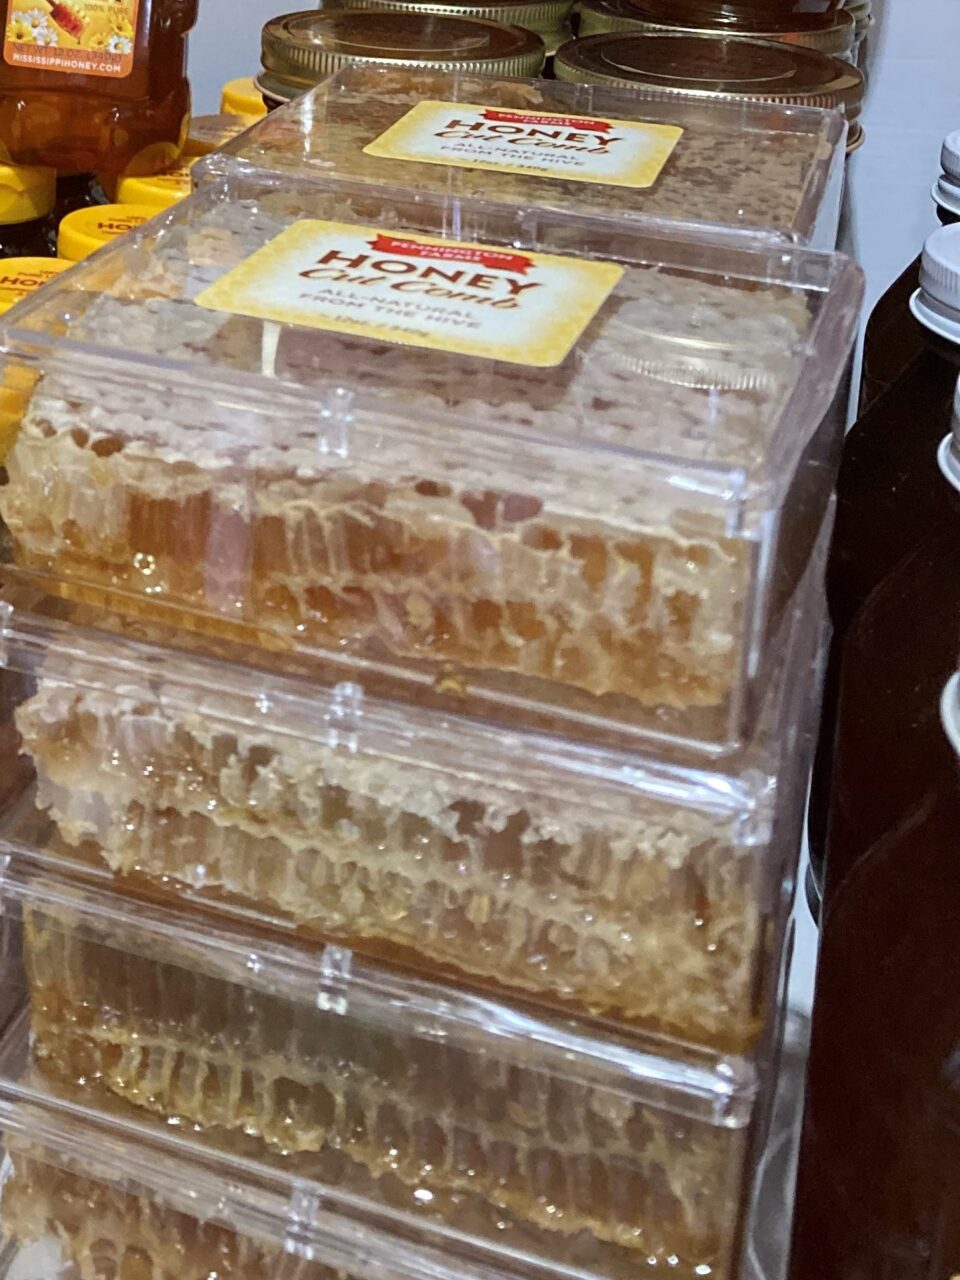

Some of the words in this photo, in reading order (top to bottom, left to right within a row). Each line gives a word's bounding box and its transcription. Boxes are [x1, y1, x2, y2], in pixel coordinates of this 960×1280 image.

[84, 3, 104, 13] 100%
[108, 6, 130, 15] PURE
[13, 53, 121, 72] MISSISSIPPIHONEY.COM
[498, 113, 596, 125] PENNINGTON
[434, 130, 503, 142] Cut
[507, 137, 610, 155] Comb
[445, 119, 624, 146] HONEY
[440, 145, 492, 156] FROM
[501, 153, 534, 161] THE
[542, 157, 586, 167] HIVE
[454, 142, 578, 161] ALL-NATURAL
[391, 240, 514, 261] PENNINGTON
[420, 250, 482, 262] FARMS
[317, 250, 543, 295] HONEY
[298, 268, 387, 286] Cut
[390, 280, 520, 309] Comb
[298, 293, 365, 309] FROM
[375, 306, 417, 318] THE
[425, 314, 482, 329] HIVE
[319, 288, 475, 319] ALL-NATURAL
